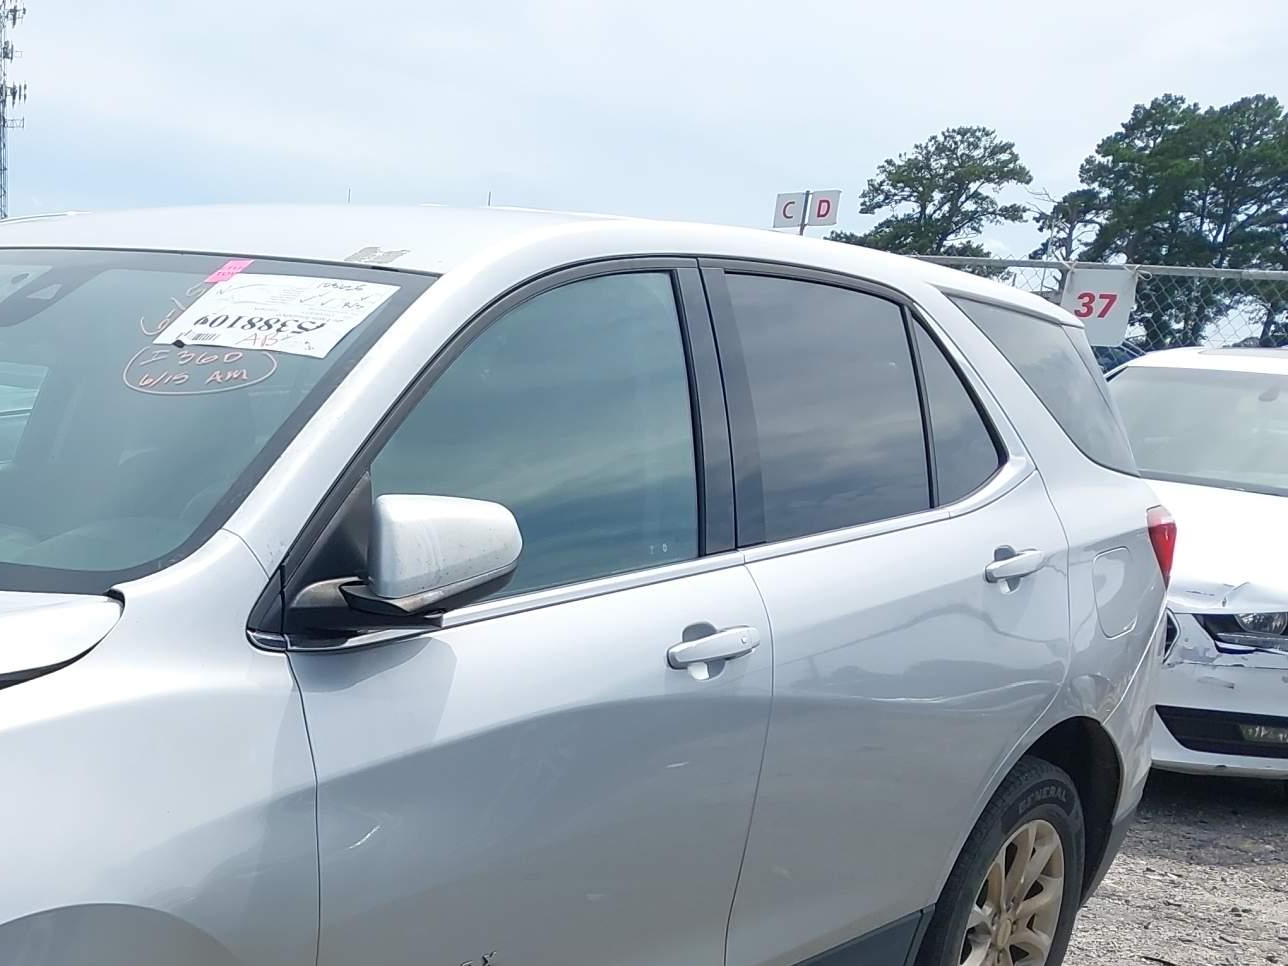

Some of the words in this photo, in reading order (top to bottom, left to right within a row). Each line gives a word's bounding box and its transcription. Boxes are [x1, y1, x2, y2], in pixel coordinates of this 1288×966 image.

[782, 201, 796, 219] C
[816, 199, 831, 218] D
[1074, 292, 1118, 318] 37
